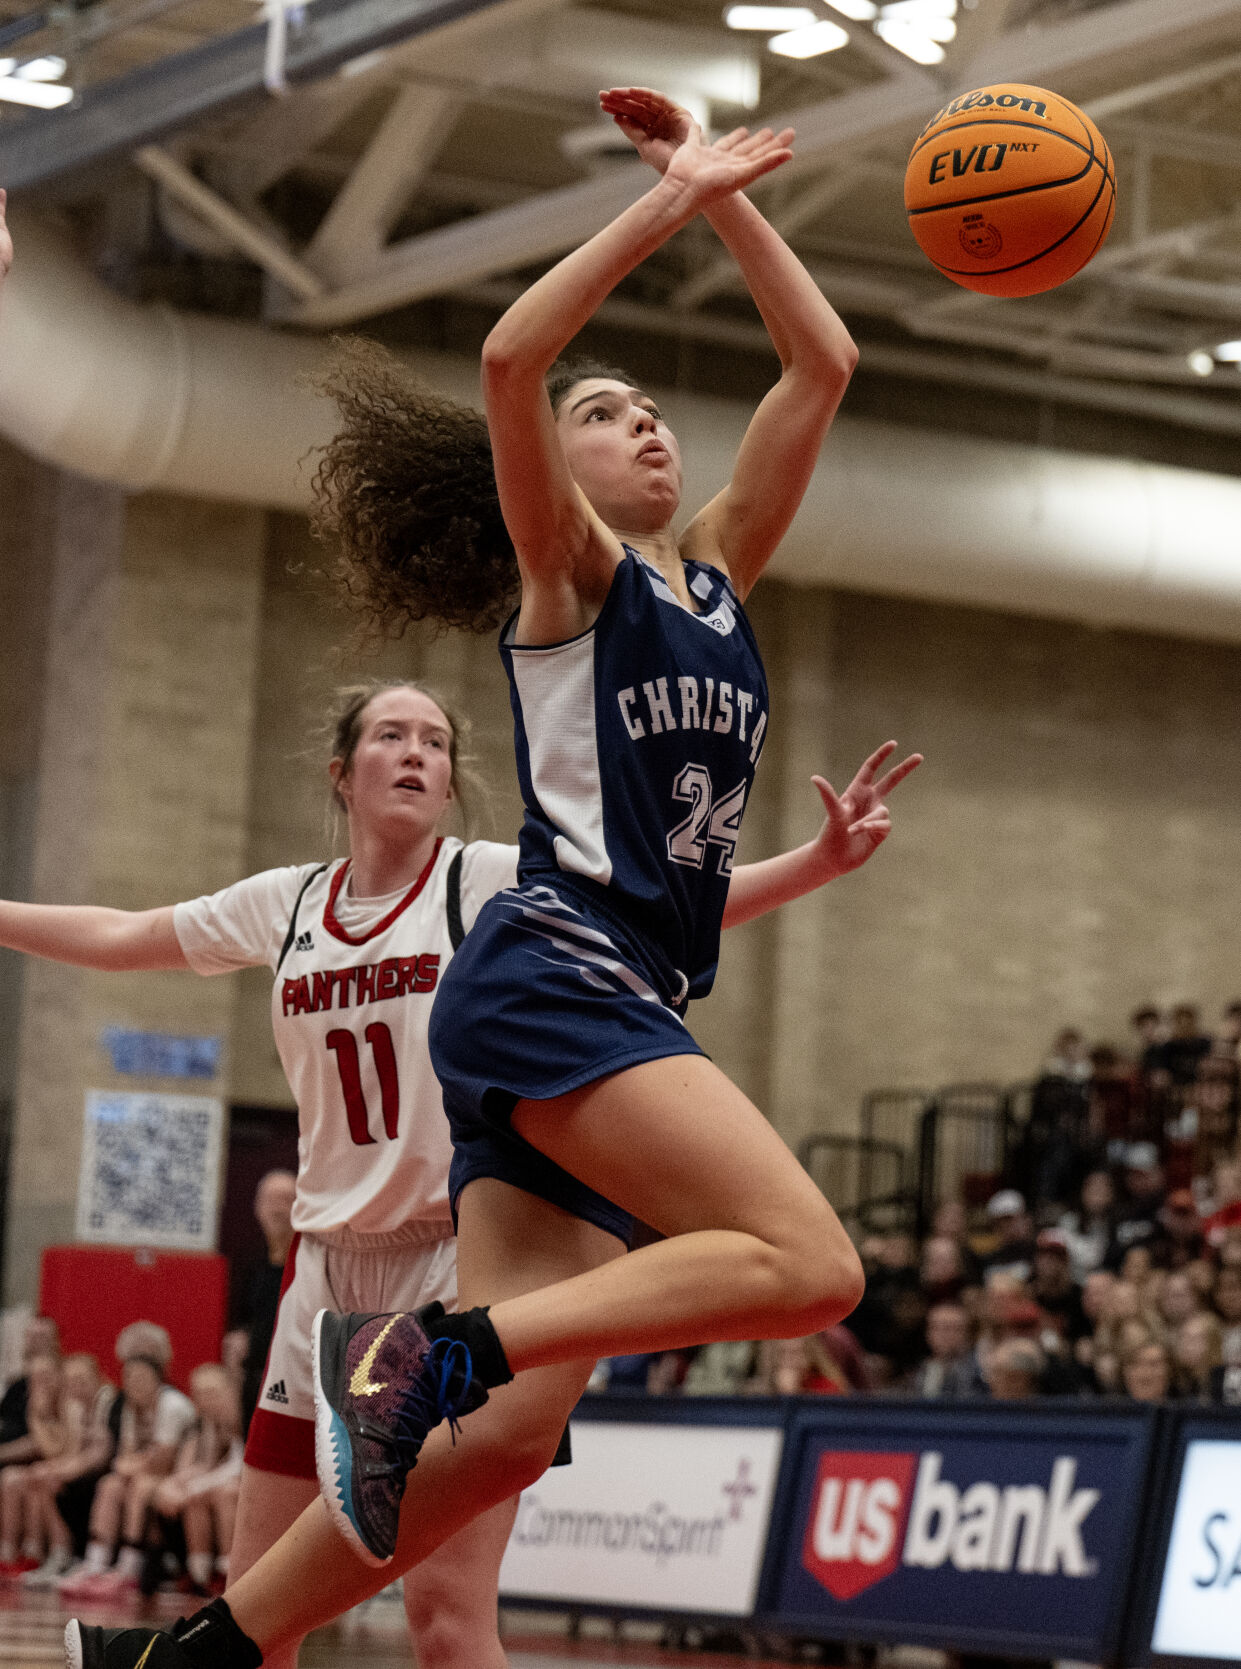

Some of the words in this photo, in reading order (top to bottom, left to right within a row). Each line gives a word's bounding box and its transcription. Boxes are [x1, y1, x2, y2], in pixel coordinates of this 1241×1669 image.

[918, 91, 1047, 139] Wilson
[929, 143, 1008, 185] EVO
[1009, 142, 1041, 153] NXT
[666, 762, 747, 878] 24
[282, 953, 440, 1017] PANTHERS
[326, 1021, 400, 1145] 11
[903, 1450, 1099, 1577] bank
